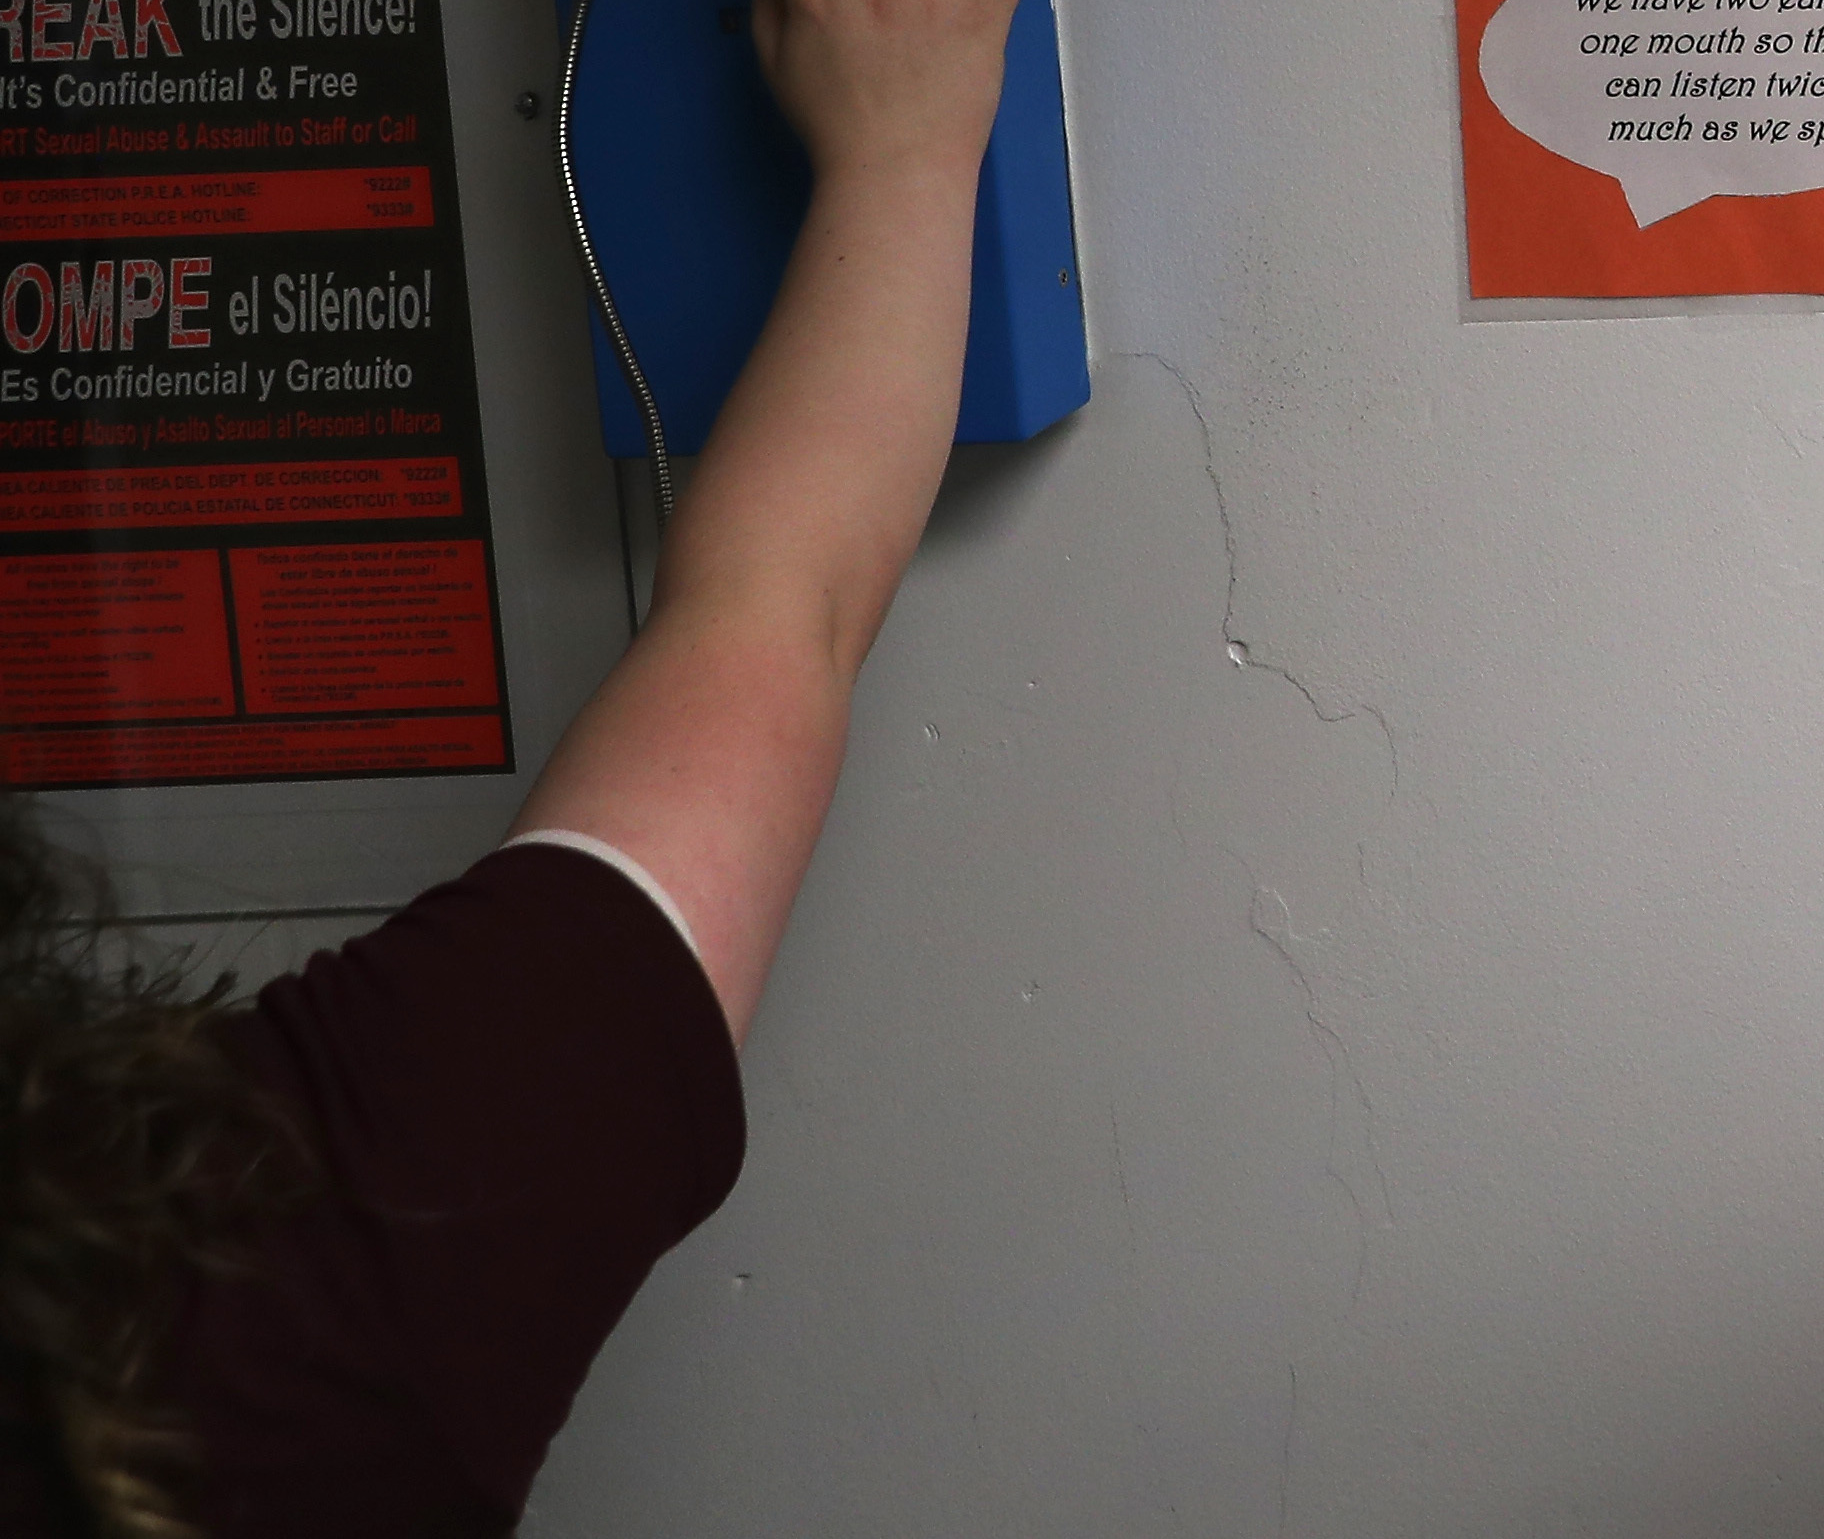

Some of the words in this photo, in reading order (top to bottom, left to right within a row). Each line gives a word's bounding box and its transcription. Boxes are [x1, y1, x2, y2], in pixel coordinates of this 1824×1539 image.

[1580, 34, 1641, 58] one
[1646, 26, 1746, 54] mouth
[1753, 33, 1794, 54] so
[55, 68, 244, 107] Confidential
[257, 67, 277, 99] &
[290, 66, 357, 98] Free
[1605, 77, 1662, 98] can
[1670, 69, 1756, 101] listen
[1608, 113, 1693, 141] much
[1702, 120, 1739, 141] as
[1749, 118, 1791, 144] we
[230, 276, 258, 335] el
[274, 270, 430, 333] Siléncio!
[1, 369, 39, 402] Es
[51, 362, 247, 400] Confidencial
[259, 369, 275, 401] y
[287, 357, 412, 391] Gratuito
